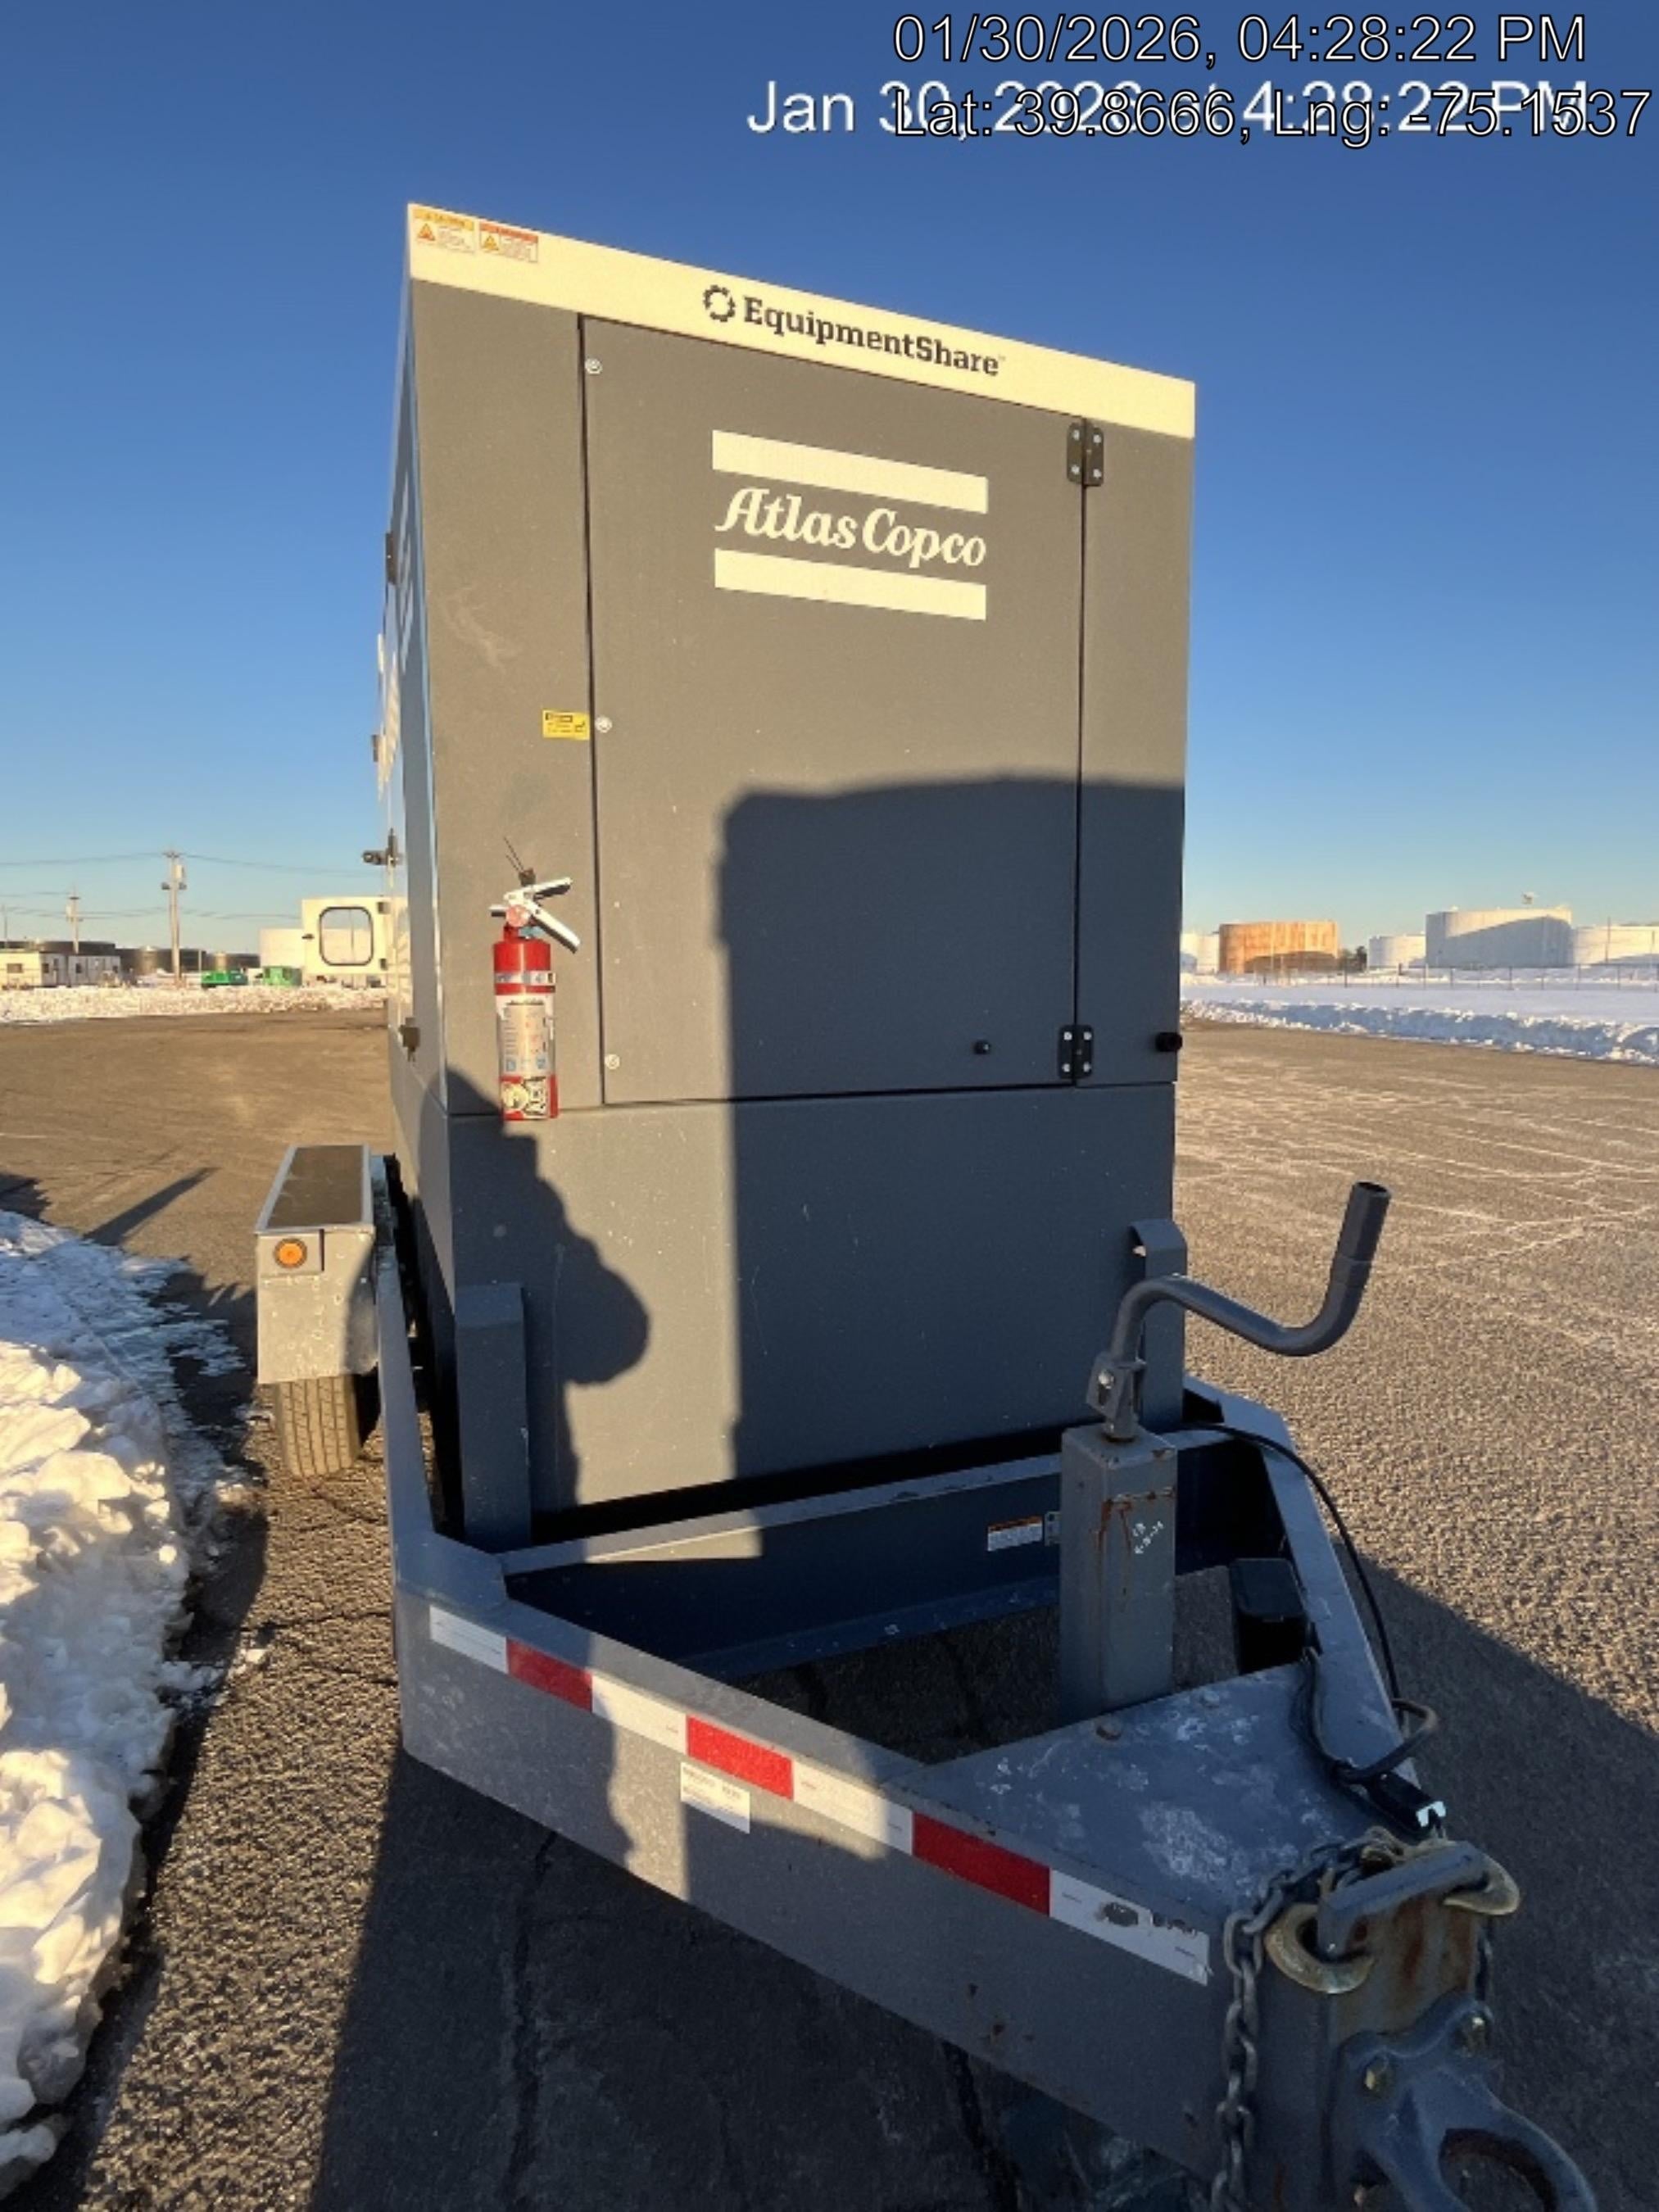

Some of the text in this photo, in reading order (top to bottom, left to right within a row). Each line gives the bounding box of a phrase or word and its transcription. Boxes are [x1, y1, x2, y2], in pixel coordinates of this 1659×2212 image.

[743, 295, 999, 376] EquipmentShare
[714, 487, 987, 569] Atlas Copco
